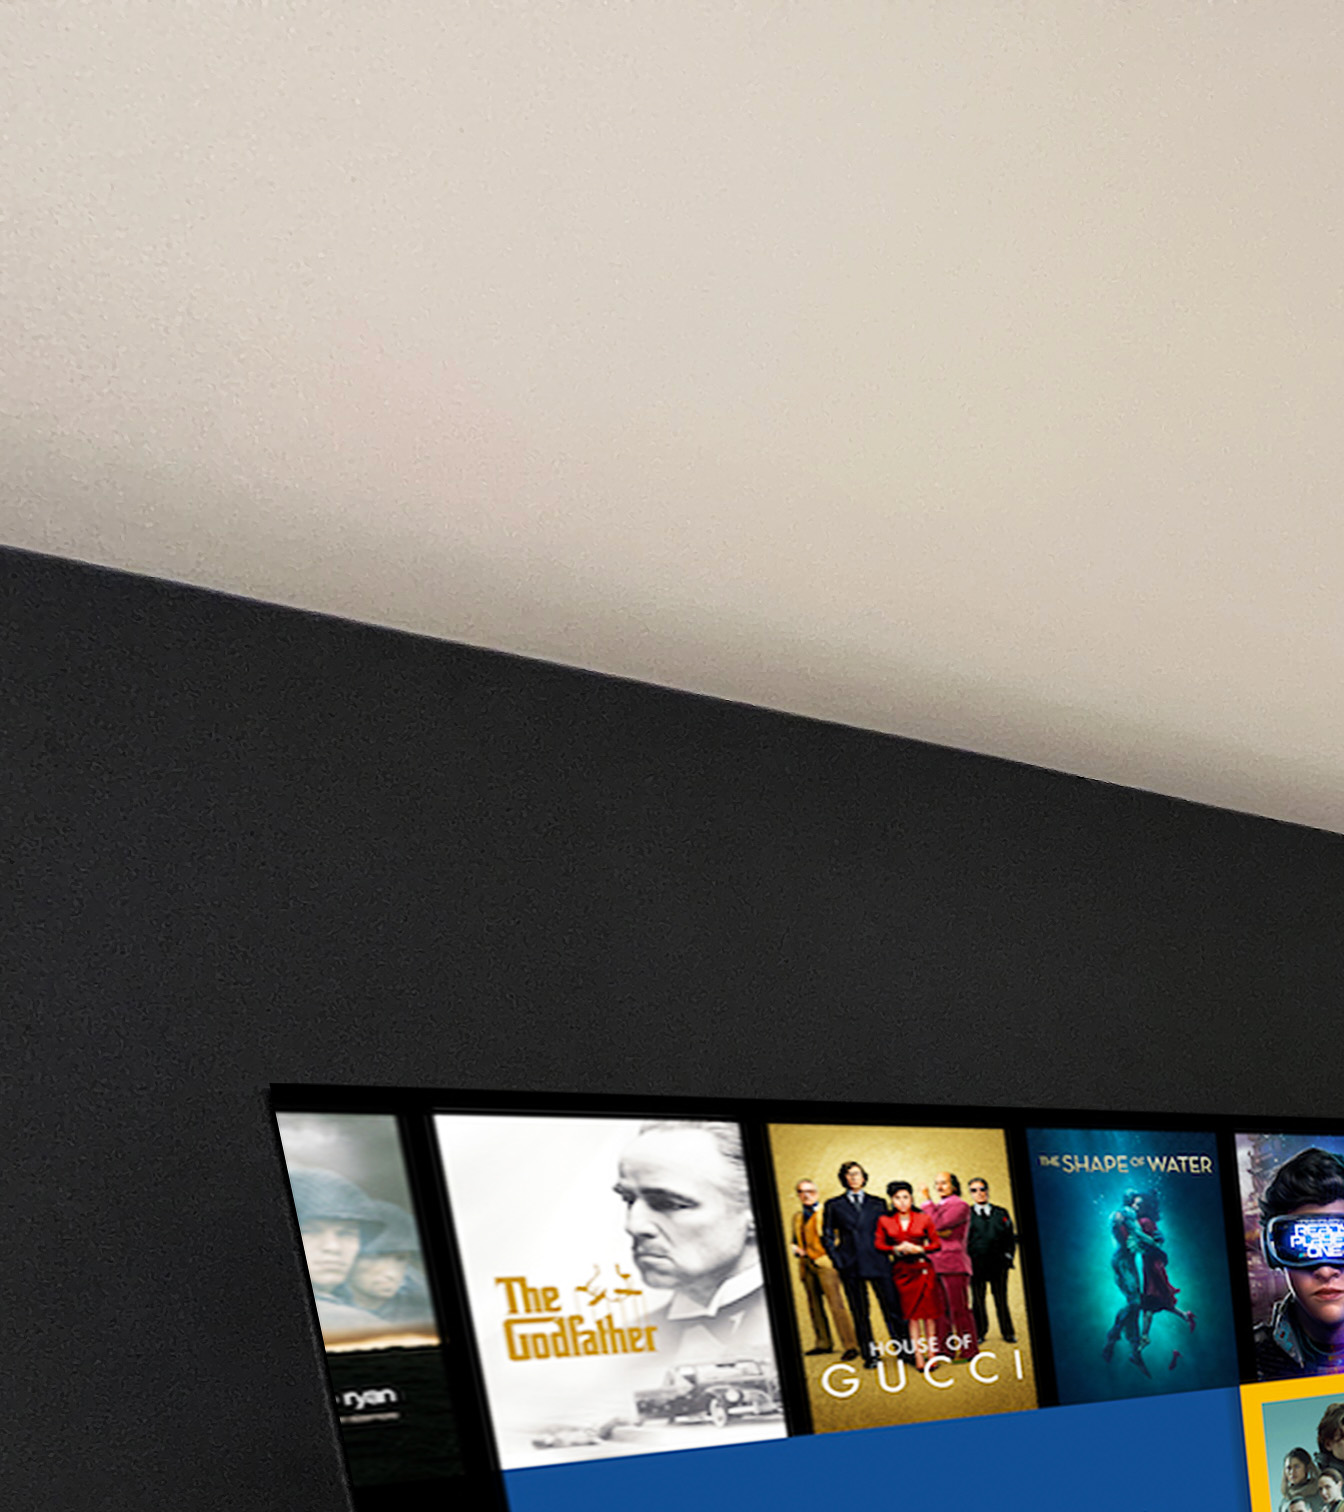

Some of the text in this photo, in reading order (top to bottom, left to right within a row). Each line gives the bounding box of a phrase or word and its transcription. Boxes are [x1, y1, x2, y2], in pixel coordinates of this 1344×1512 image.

[1062, 1154, 1129, 1174] SHAPE
[1146, 1155, 1213, 1174] WATER
[1307, 1245, 1343, 1258] ONE
[494, 1276, 562, 1314] The
[503, 1313, 658, 1362] Godfather
[869, 1334, 972, 1357] HOUSE OF
[821, 1349, 1024, 1398] GUCCI
